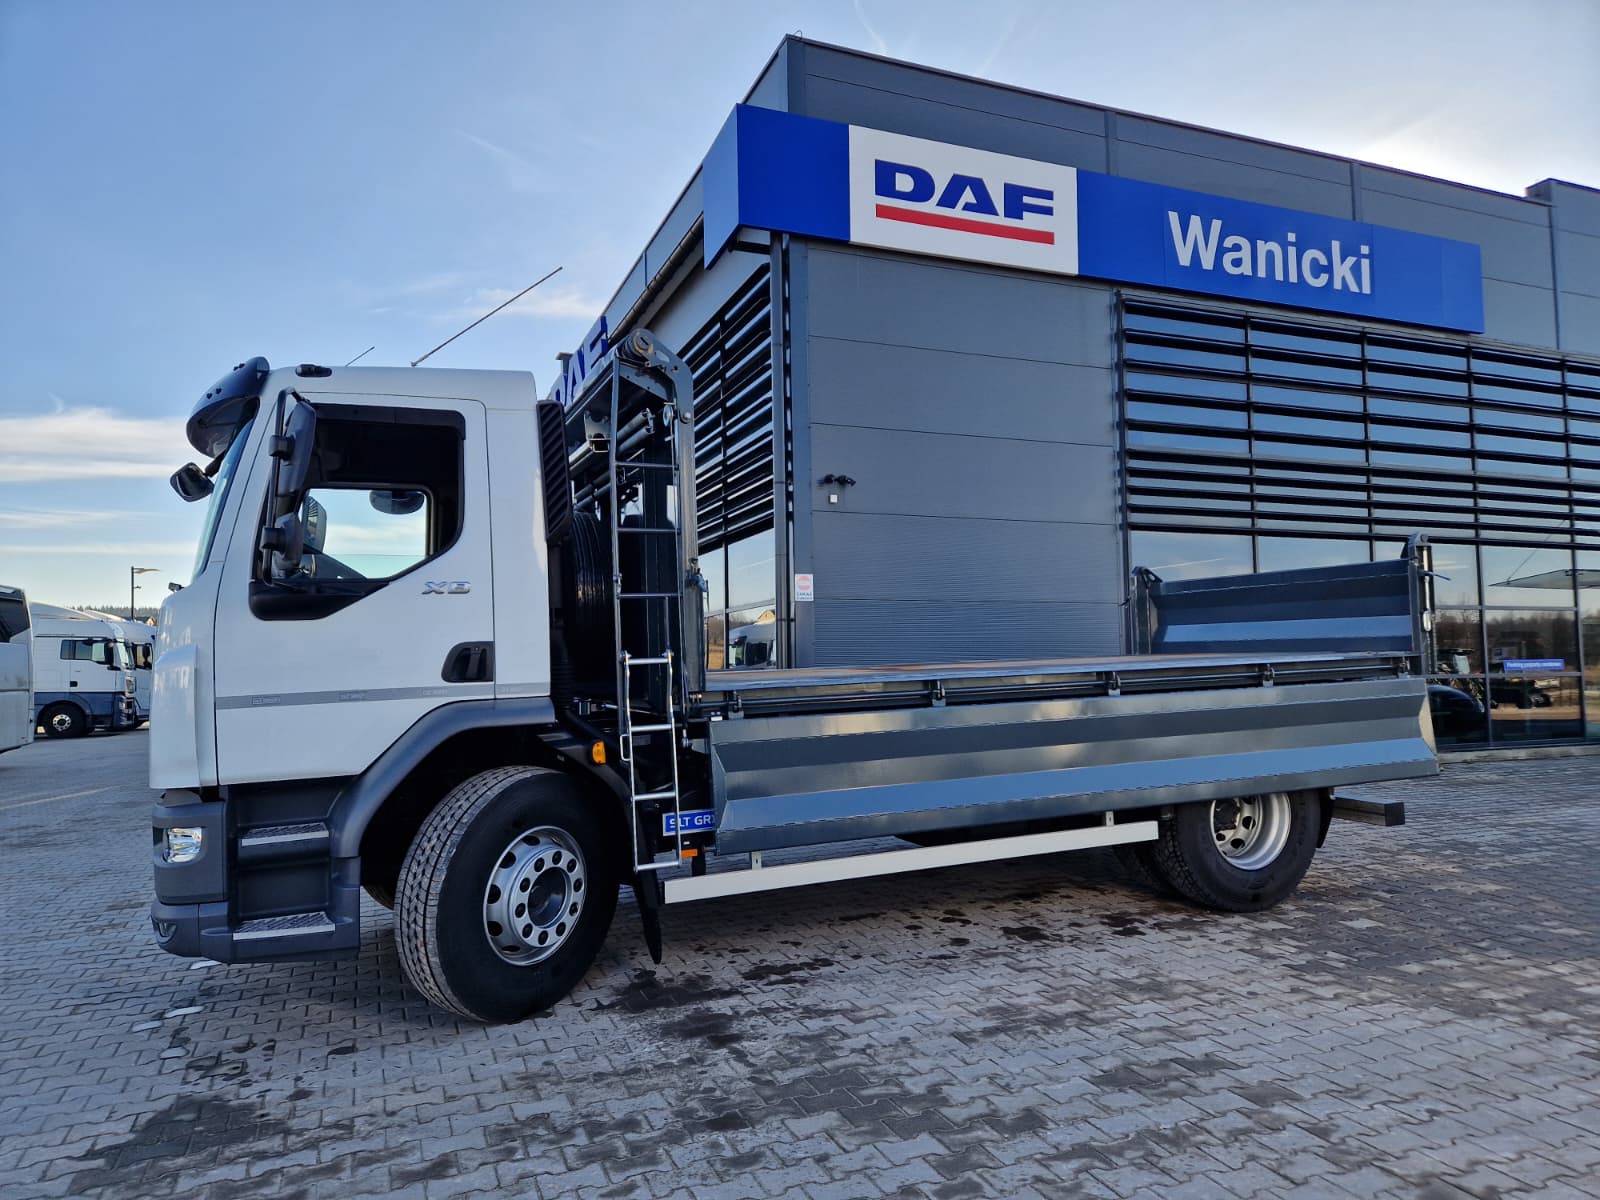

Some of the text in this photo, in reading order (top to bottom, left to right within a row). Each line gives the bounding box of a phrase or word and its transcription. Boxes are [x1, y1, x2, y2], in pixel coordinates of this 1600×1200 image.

[875, 159, 1054, 221] DAF
[1168, 210, 1372, 295] Wanicki
[694, 814, 714, 826] GR
